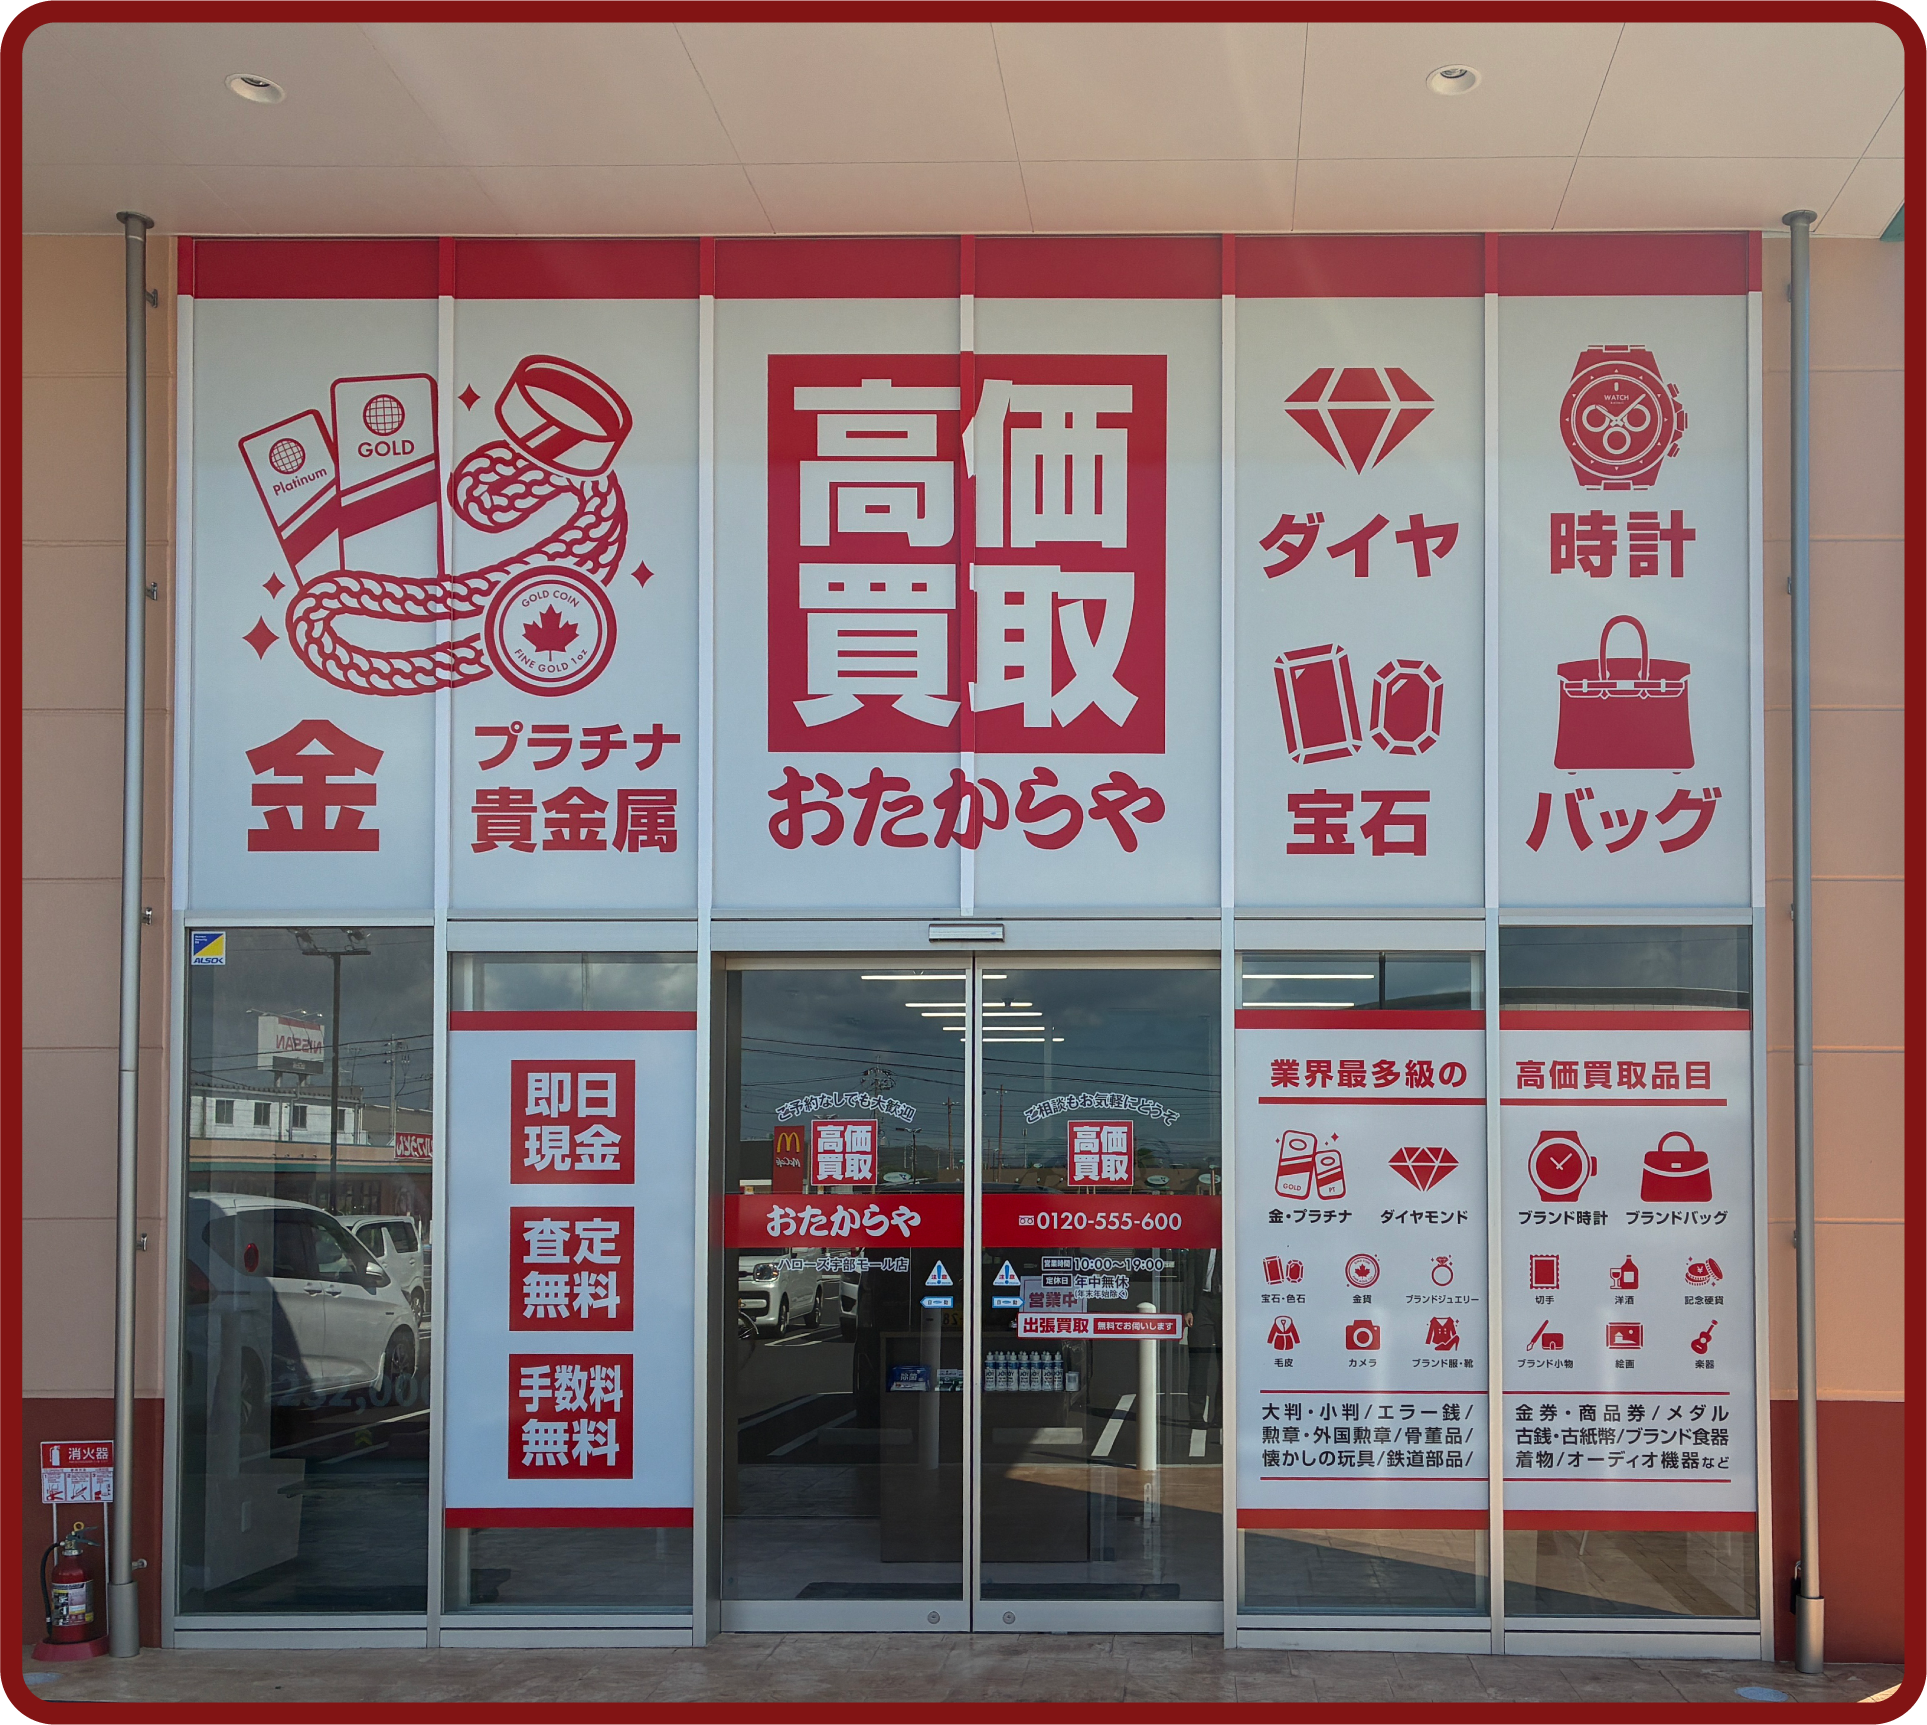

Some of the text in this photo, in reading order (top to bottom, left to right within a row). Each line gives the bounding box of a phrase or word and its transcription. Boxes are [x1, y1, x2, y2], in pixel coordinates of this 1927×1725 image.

[357, 439, 415, 458] GOLD
[794, 378, 1133, 549] 高価
[272, 468, 328, 496] Platinum
[1258, 511, 1459, 579] ダイヤ
[1550, 509, 1696, 578] 時計
[521, 590, 580, 608] GOLD COIN
[793, 562, 1140, 728] 買取
[514, 648, 537, 669] FINE
[538, 662, 569, 673] GOLD
[474, 720, 681, 771] プラチナ
[245, 718, 384, 852] 金
[471, 786, 678, 853] 貴金属
[767, 765, 1166, 853] おたからや
[1525, 786, 1722, 854] バッグ
[1286, 788, 1431, 857] 宝石
[1270, 1058, 1467, 1088] 業界最多級の
[1515, 1060, 1711, 1090] 高価買取品目
[524, 1072, 617, 1118] 即日
[775, 1092, 917, 1123] ご予約なしでも大歓迎
[1024, 1091, 1181, 1127] ご相談もお気軽にどうぞ
[523, 1123, 622, 1171] 現金
[816, 1124, 873, 1153] 高価
[1073, 1125, 1128, 1153] 高価
[816, 1153, 873, 1181] 買取
[1073, 1154, 1129, 1182] 買取
[1282, 1182, 1302, 1192] GOLD
[766, 1203, 921, 1238] おたからや
[1036, 1212, 1182, 1231] 0120-555-600
[1268, 1208, 1353, 1224] 金・プラチナ
[1380, 1209, 1468, 1225] ダイヤモンド
[1518, 1210, 1609, 1226] ブランド時計
[1625, 1210, 1729, 1226] ブランドバッグ
[522, 1217, 622, 1265] 査定
[777, 1257, 910, 1272] ハローズ宇部モール店
[1043, 1259, 1071, 1268] 営業時間
[521, 1270, 621, 1319] 無料
[1045, 1275, 1130, 1289] 定休日 年中無休
[1028, 1291, 1078, 1309] 営業中
[1261, 1293, 1306, 1304] 宝石・色石
[1352, 1294, 1372, 1304] 金貨
[1405, 1294, 1480, 1304] ブランドジュエリー
[1535, 1295, 1555, 1305] 切手
[1614, 1295, 1635, 1305] 洋酒
[1684, 1295, 1725, 1305] 記念硬貨
[1023, 1317, 1174, 1334] 出張買取 無料でお伺いします
[1273, 1358, 1294, 1368] 毛皮
[1348, 1358, 1378, 1368] カメラ
[1412, 1358, 1474, 1369] ブランド服・靴
[1517, 1359, 1574, 1369] ブランド小物
[1615, 1359, 1635, 1369] 絵画
[1694, 1359, 1715, 1369] 楽器
[518, 1364, 624, 1413] 手数料
[68, 1447, 109, 1461] 消火器
[521, 1418, 621, 1467] 無料
